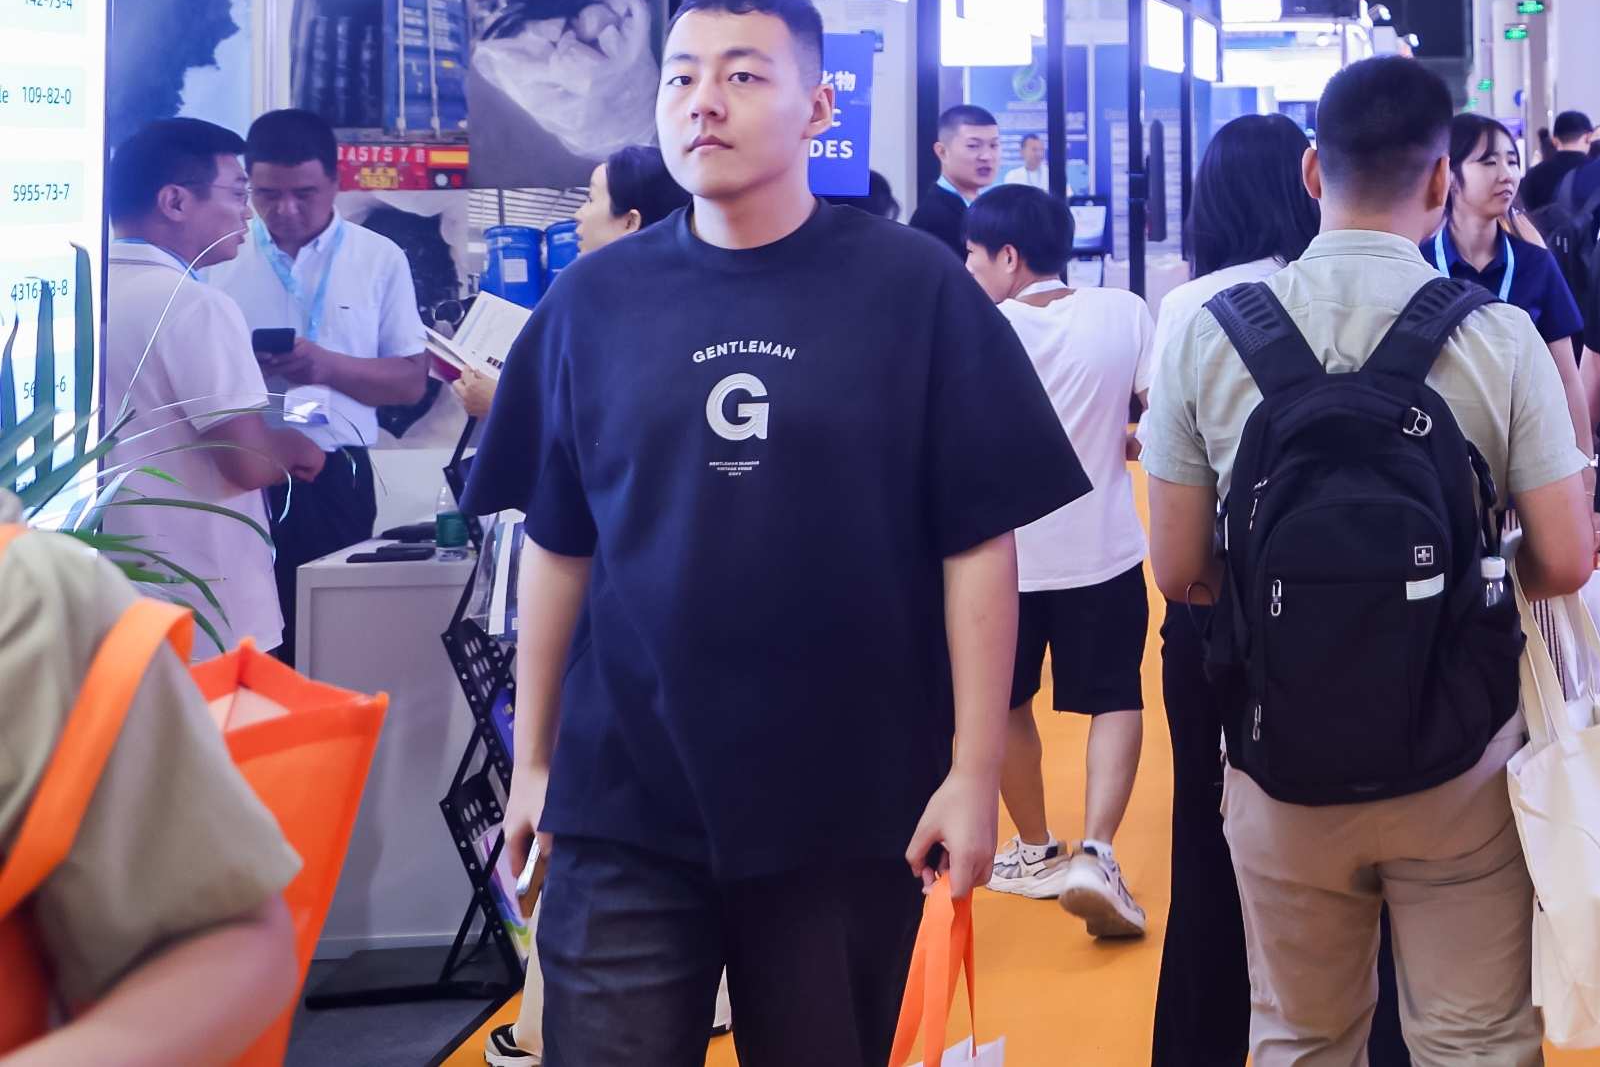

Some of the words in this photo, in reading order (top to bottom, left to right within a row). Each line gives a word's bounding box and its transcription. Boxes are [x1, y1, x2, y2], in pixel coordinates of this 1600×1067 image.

[21, 86, 72, 105] 109-82-0
[12, 183, 70, 202] 5955-73-7
[11, 279, 68, 302] 4316-3-8
[692, 340, 796, 363] GENTLEMAN
[705, 372, 770, 441] G
